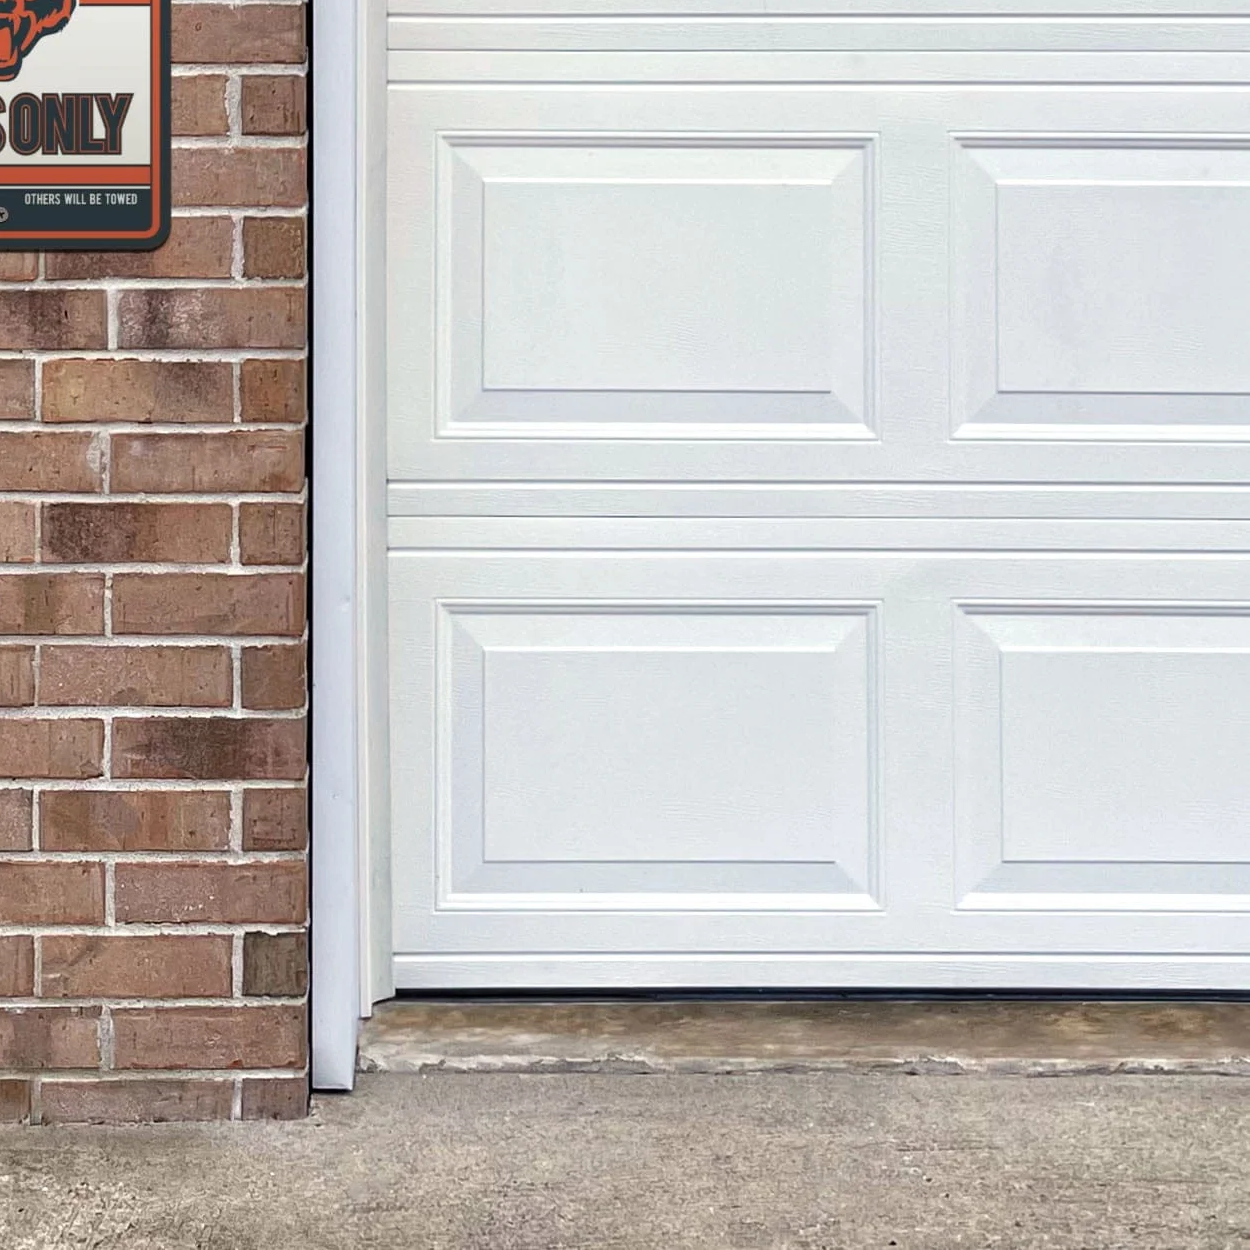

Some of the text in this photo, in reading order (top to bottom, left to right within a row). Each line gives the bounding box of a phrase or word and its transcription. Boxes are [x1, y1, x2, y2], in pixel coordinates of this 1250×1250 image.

[9, 92, 134, 156] ONLY
[24, 193, 138, 205] OTHERS WILL BE TOWED
